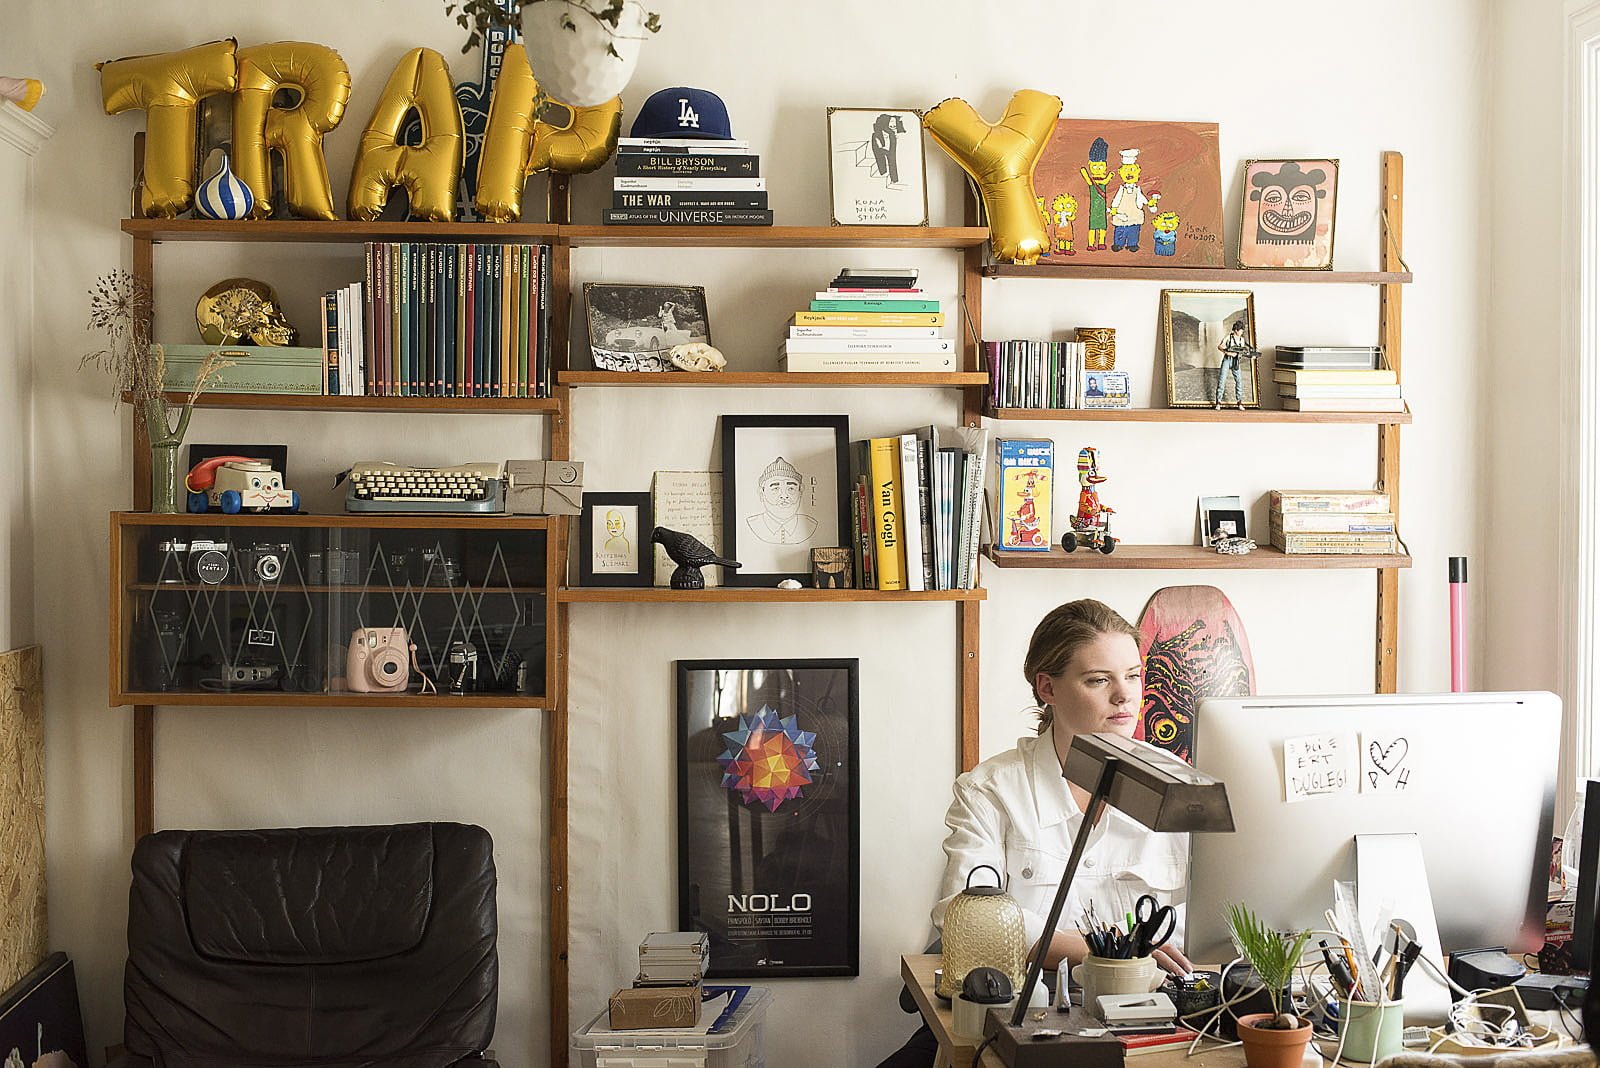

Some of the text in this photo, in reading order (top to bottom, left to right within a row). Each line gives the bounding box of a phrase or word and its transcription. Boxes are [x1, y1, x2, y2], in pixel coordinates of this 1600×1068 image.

[678, 98, 700, 128] LA
[650, 157, 714, 166] BILL BRYSON
[622, 195, 643, 206] THE
[648, 195, 671, 206] WAR
[660, 212, 724, 223] UNIVERSE
[881, 480, 896, 548] Van Gogh
[728, 894, 811, 912] NOLO
